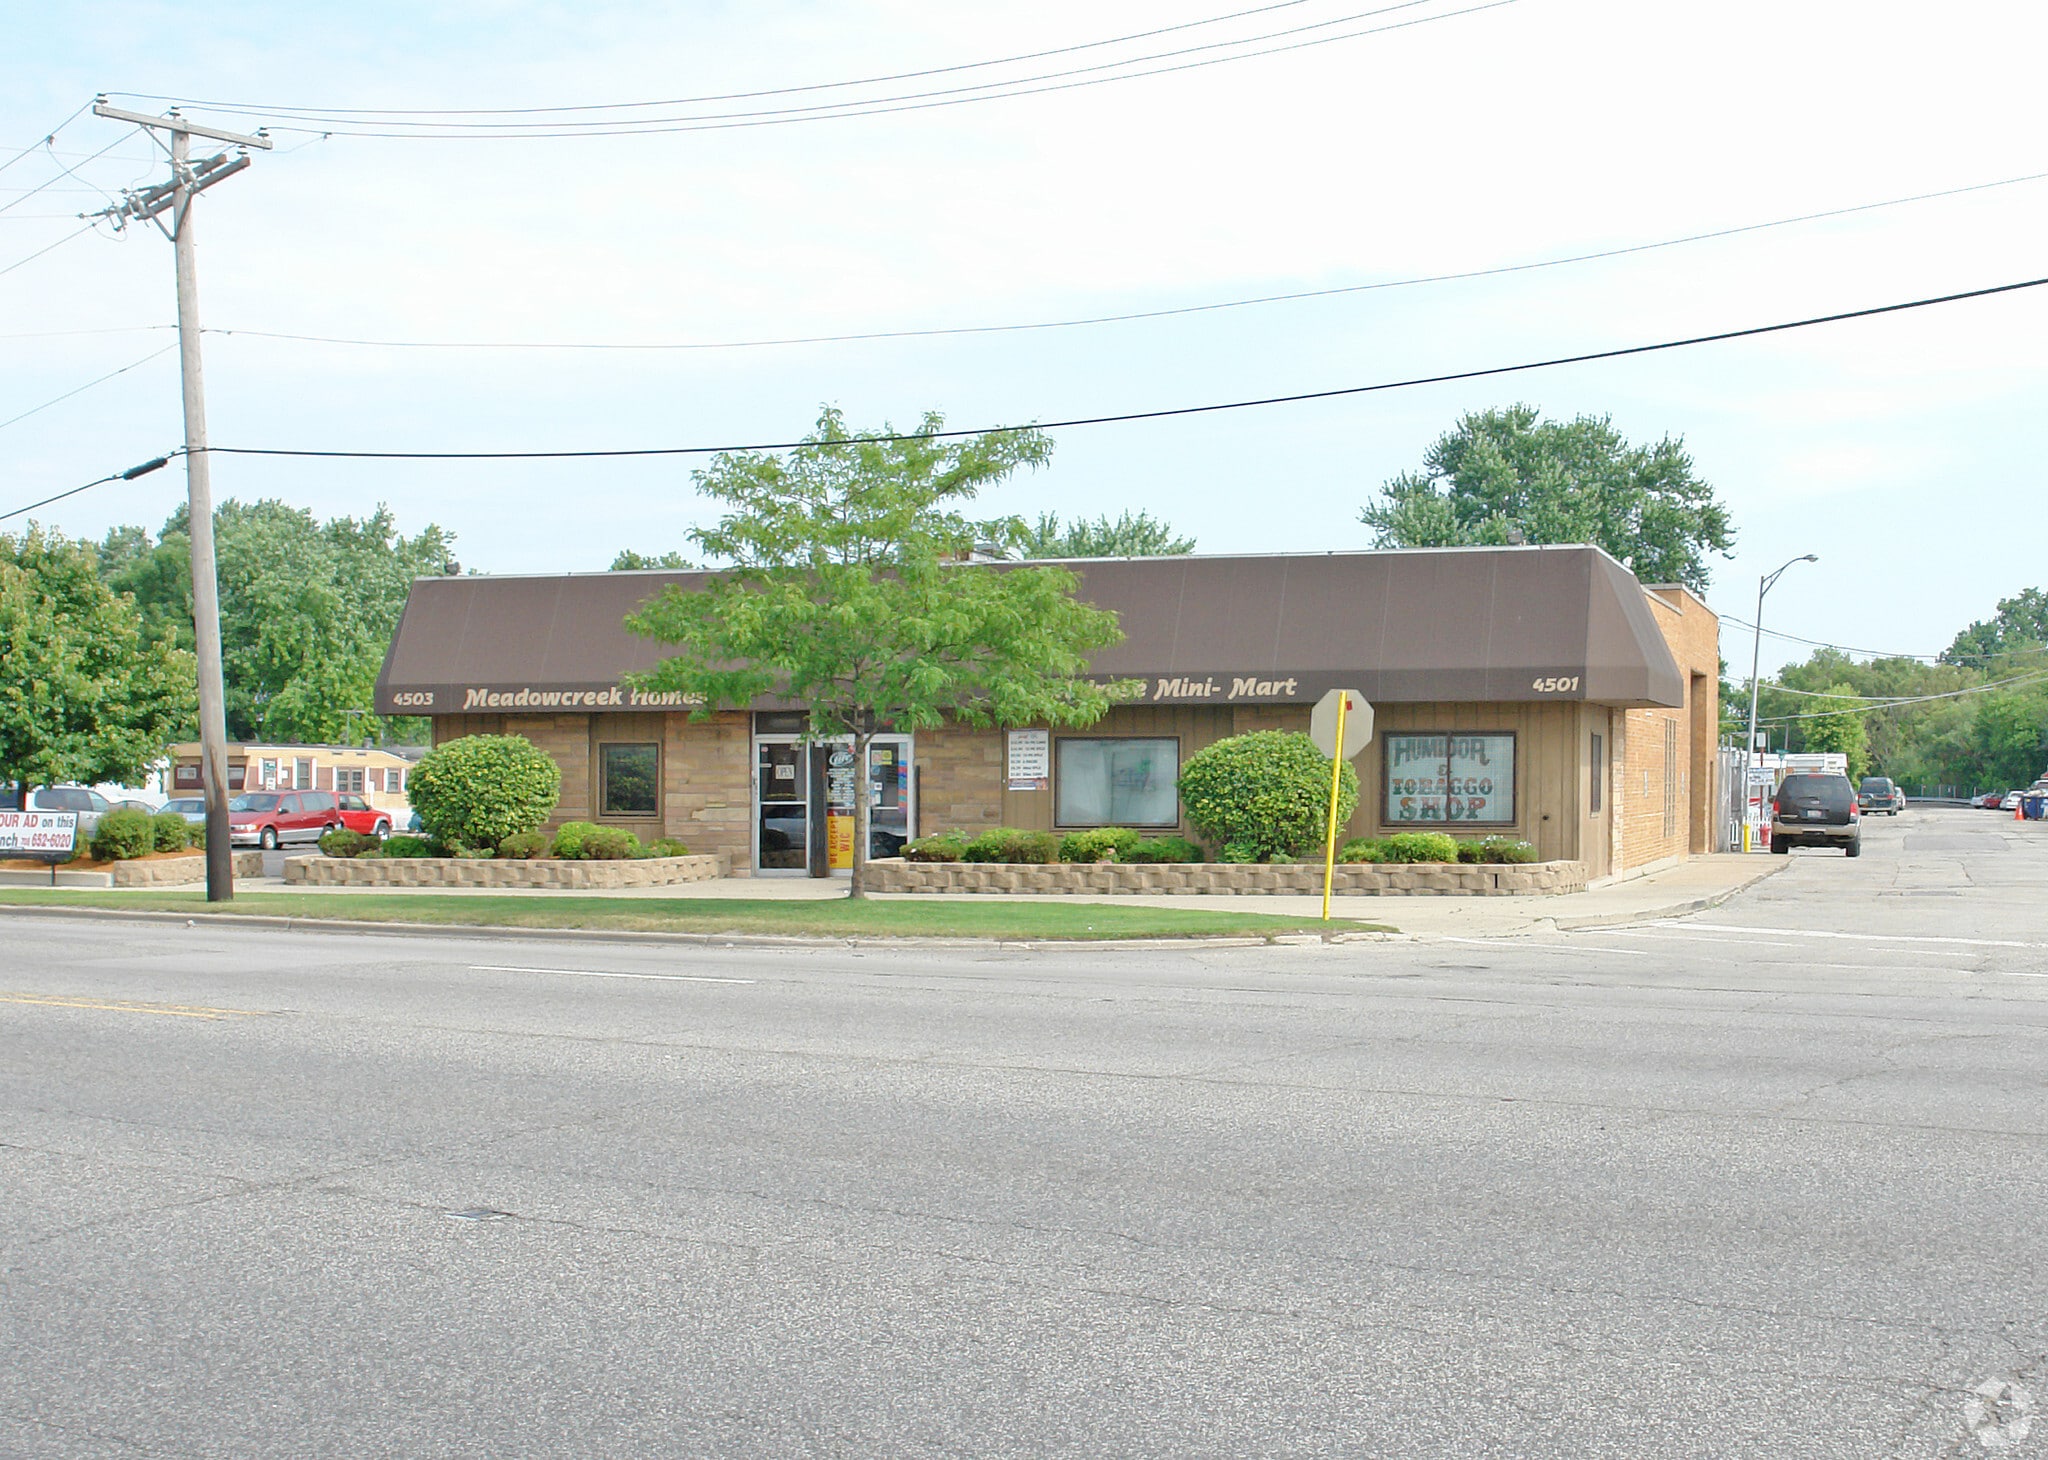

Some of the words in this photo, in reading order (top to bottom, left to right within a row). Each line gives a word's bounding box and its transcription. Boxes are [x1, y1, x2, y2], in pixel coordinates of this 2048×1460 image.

[1153, 677, 1221, 700] Mini-
[1228, 677, 1298, 700] Mart
[1532, 676, 1579, 692] 4501
[392, 692, 434, 706] 4503
[463, 687, 622, 710] Meadowcreek
[1394, 738, 1491, 767] HUMIDOR
[1399, 796, 1487, 820] SHOP
[23, 814, 38, 828] AD
[41, 818, 54, 828] on
[57, 815, 74, 828] this
[32, 833, 71, 847] 652-6020
[839, 832, 851, 852] WIC
